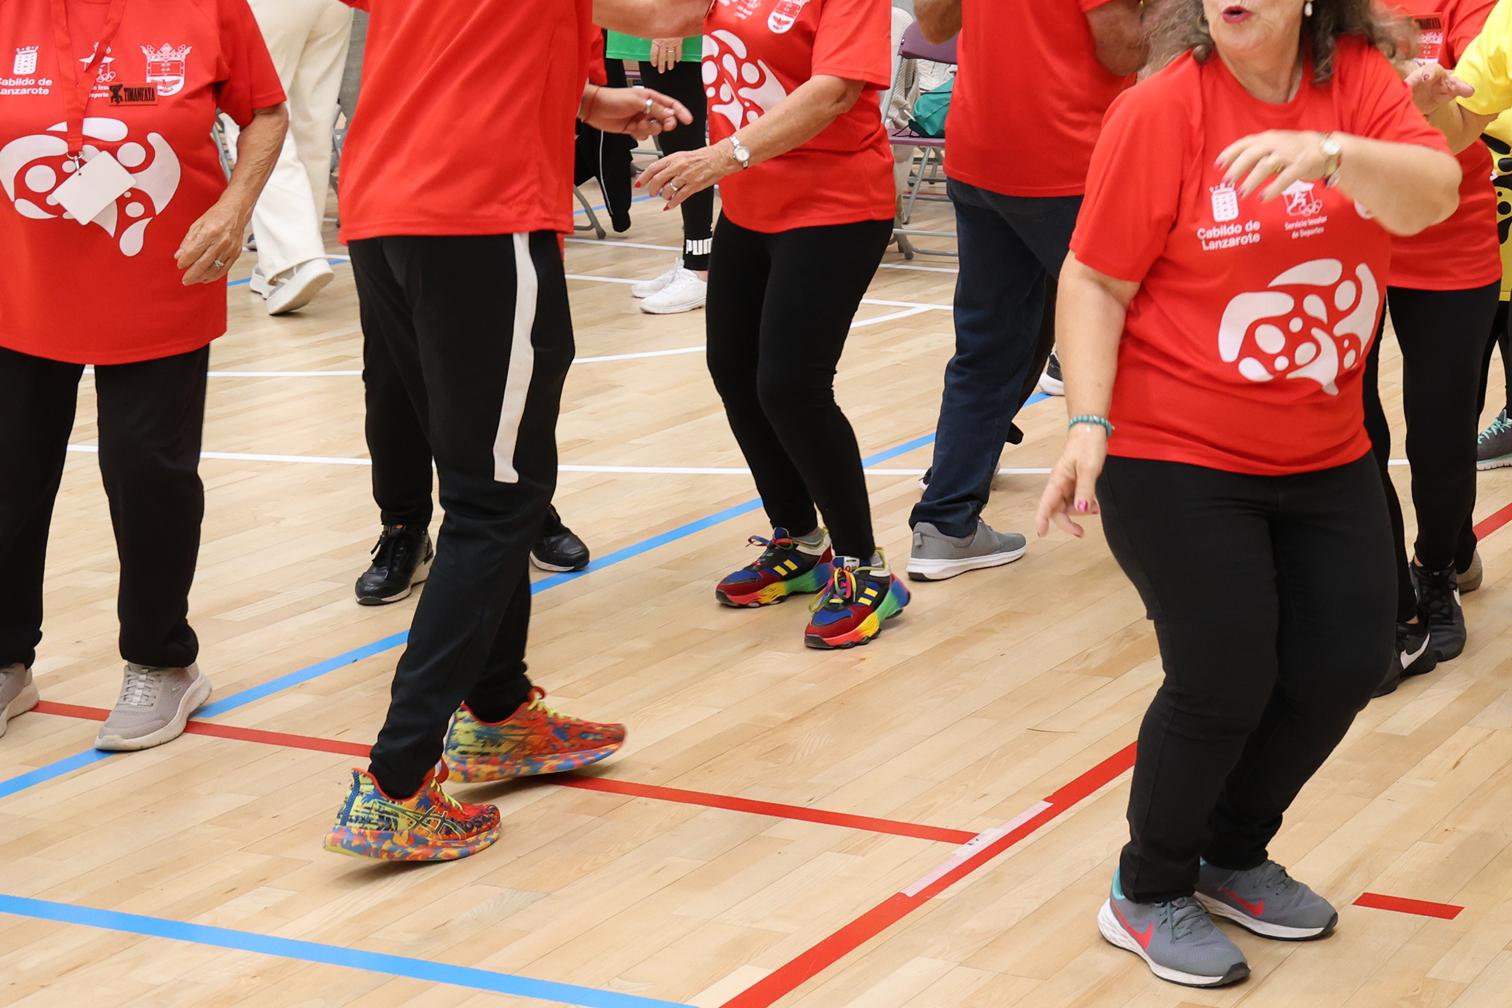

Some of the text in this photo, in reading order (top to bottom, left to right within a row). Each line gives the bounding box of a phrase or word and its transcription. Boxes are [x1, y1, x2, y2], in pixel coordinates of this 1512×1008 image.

[38, 77, 53, 86] de
[0, 87, 50, 95] anzarote
[1196, 220, 1261, 240] Cabildo de
[1201, 232, 1261, 251] Lanzarote
